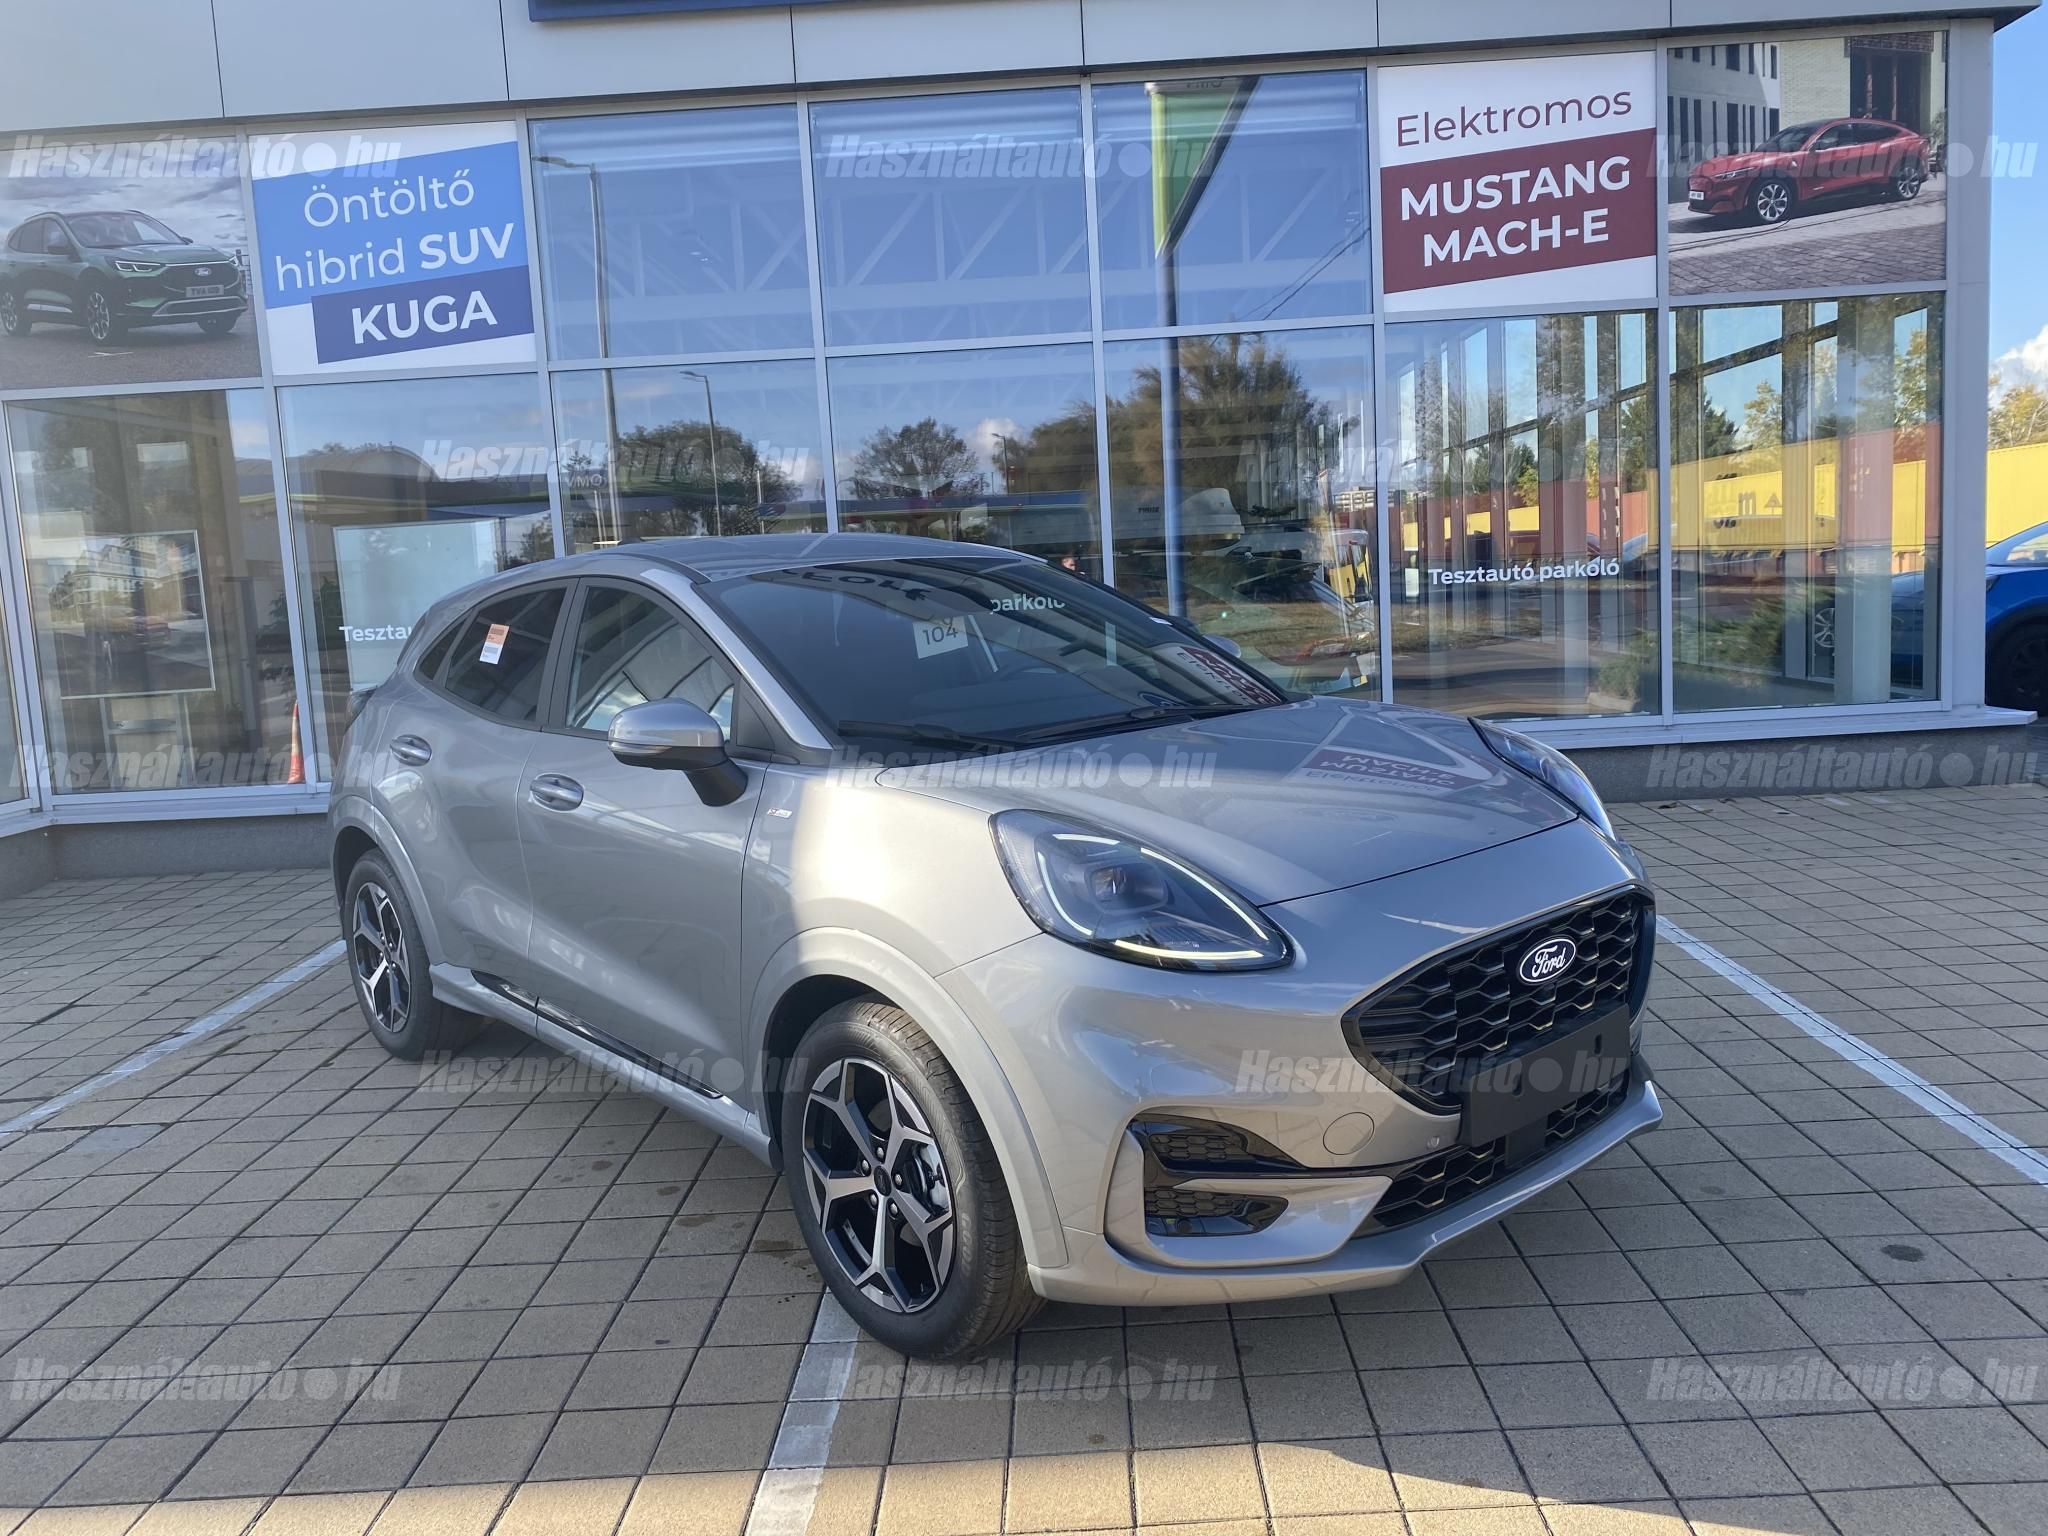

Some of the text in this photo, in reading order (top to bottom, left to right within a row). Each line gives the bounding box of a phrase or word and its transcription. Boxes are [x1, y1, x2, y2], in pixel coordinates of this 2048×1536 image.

[1396, 89, 1633, 149] Elektromos
[303, 168, 475, 229] Öntöltő
[1400, 156, 1631, 221] MUSTANG
[276, 223, 515, 292] hibrid SUV
[1422, 208, 1609, 267] MACH-E
[351, 290, 498, 345] KUGA
[1428, 558, 1620, 585] Tesztautó parkoló
[922, 626, 959, 646] 104
[1531, 945, 1567, 978] Ford
